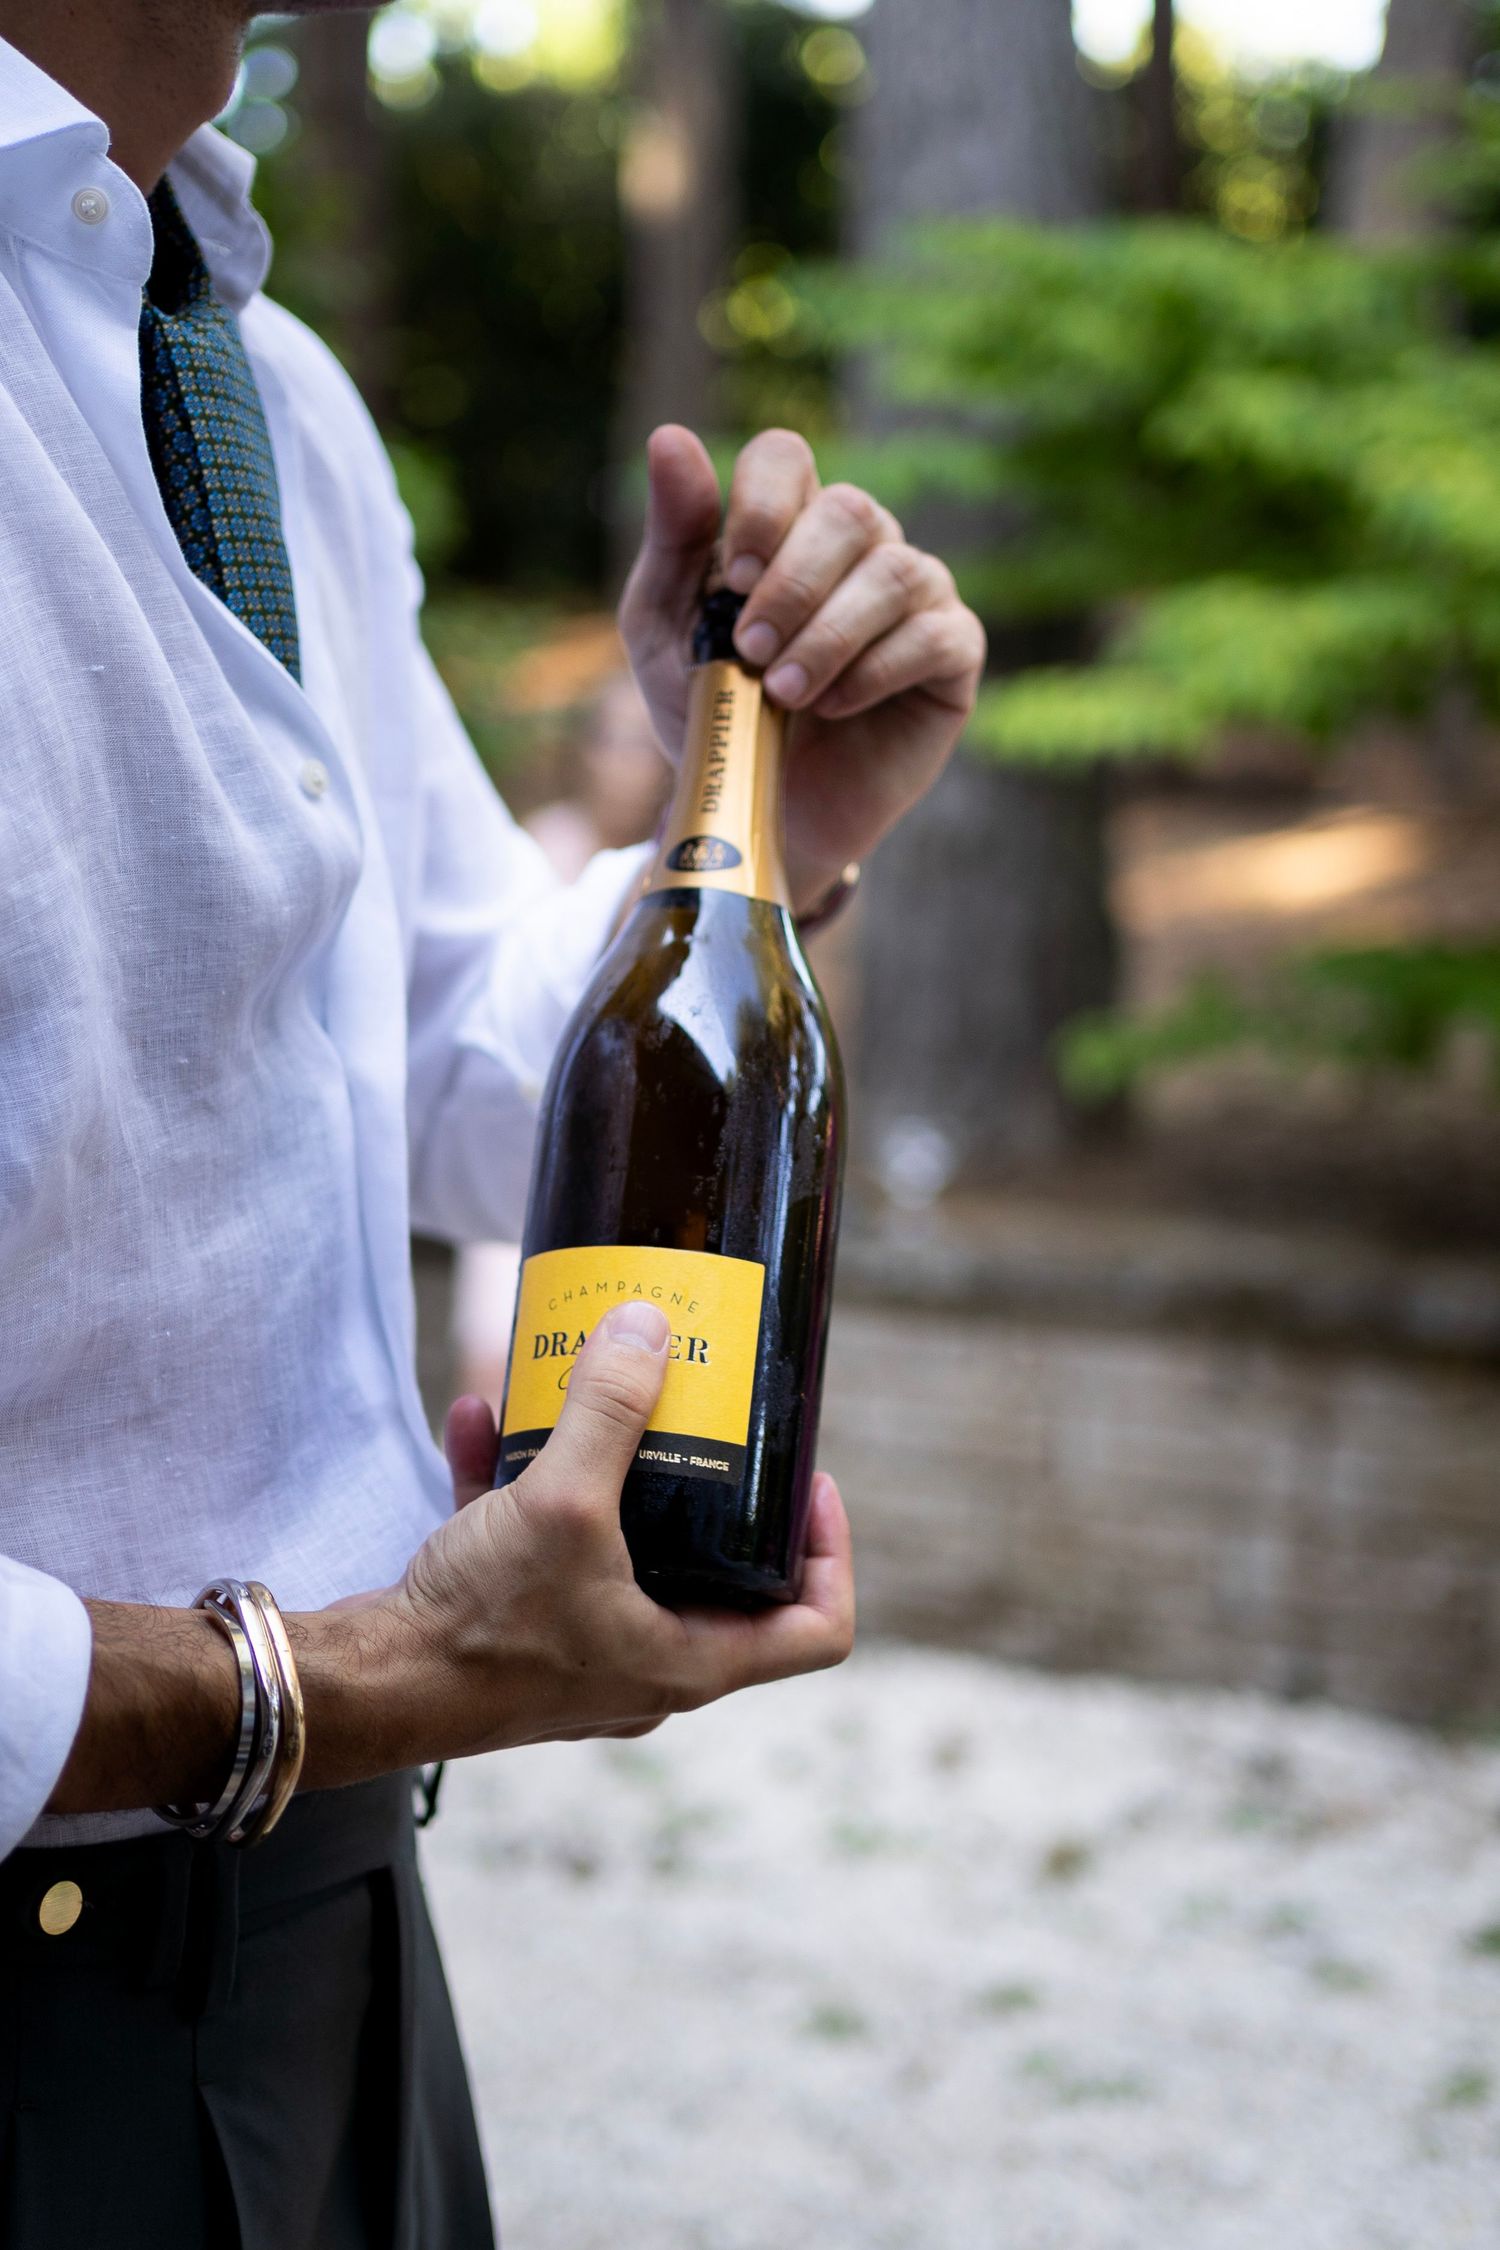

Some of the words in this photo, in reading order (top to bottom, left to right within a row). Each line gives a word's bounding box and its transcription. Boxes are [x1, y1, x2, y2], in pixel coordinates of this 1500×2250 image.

[701, 689, 736, 813] DRAPPIER
[549, 1280, 699, 1314] CHAMPAGNE
[533, 1331, 710, 1364] DRAER
[689, 1456, 730, 1472] FRANCE
